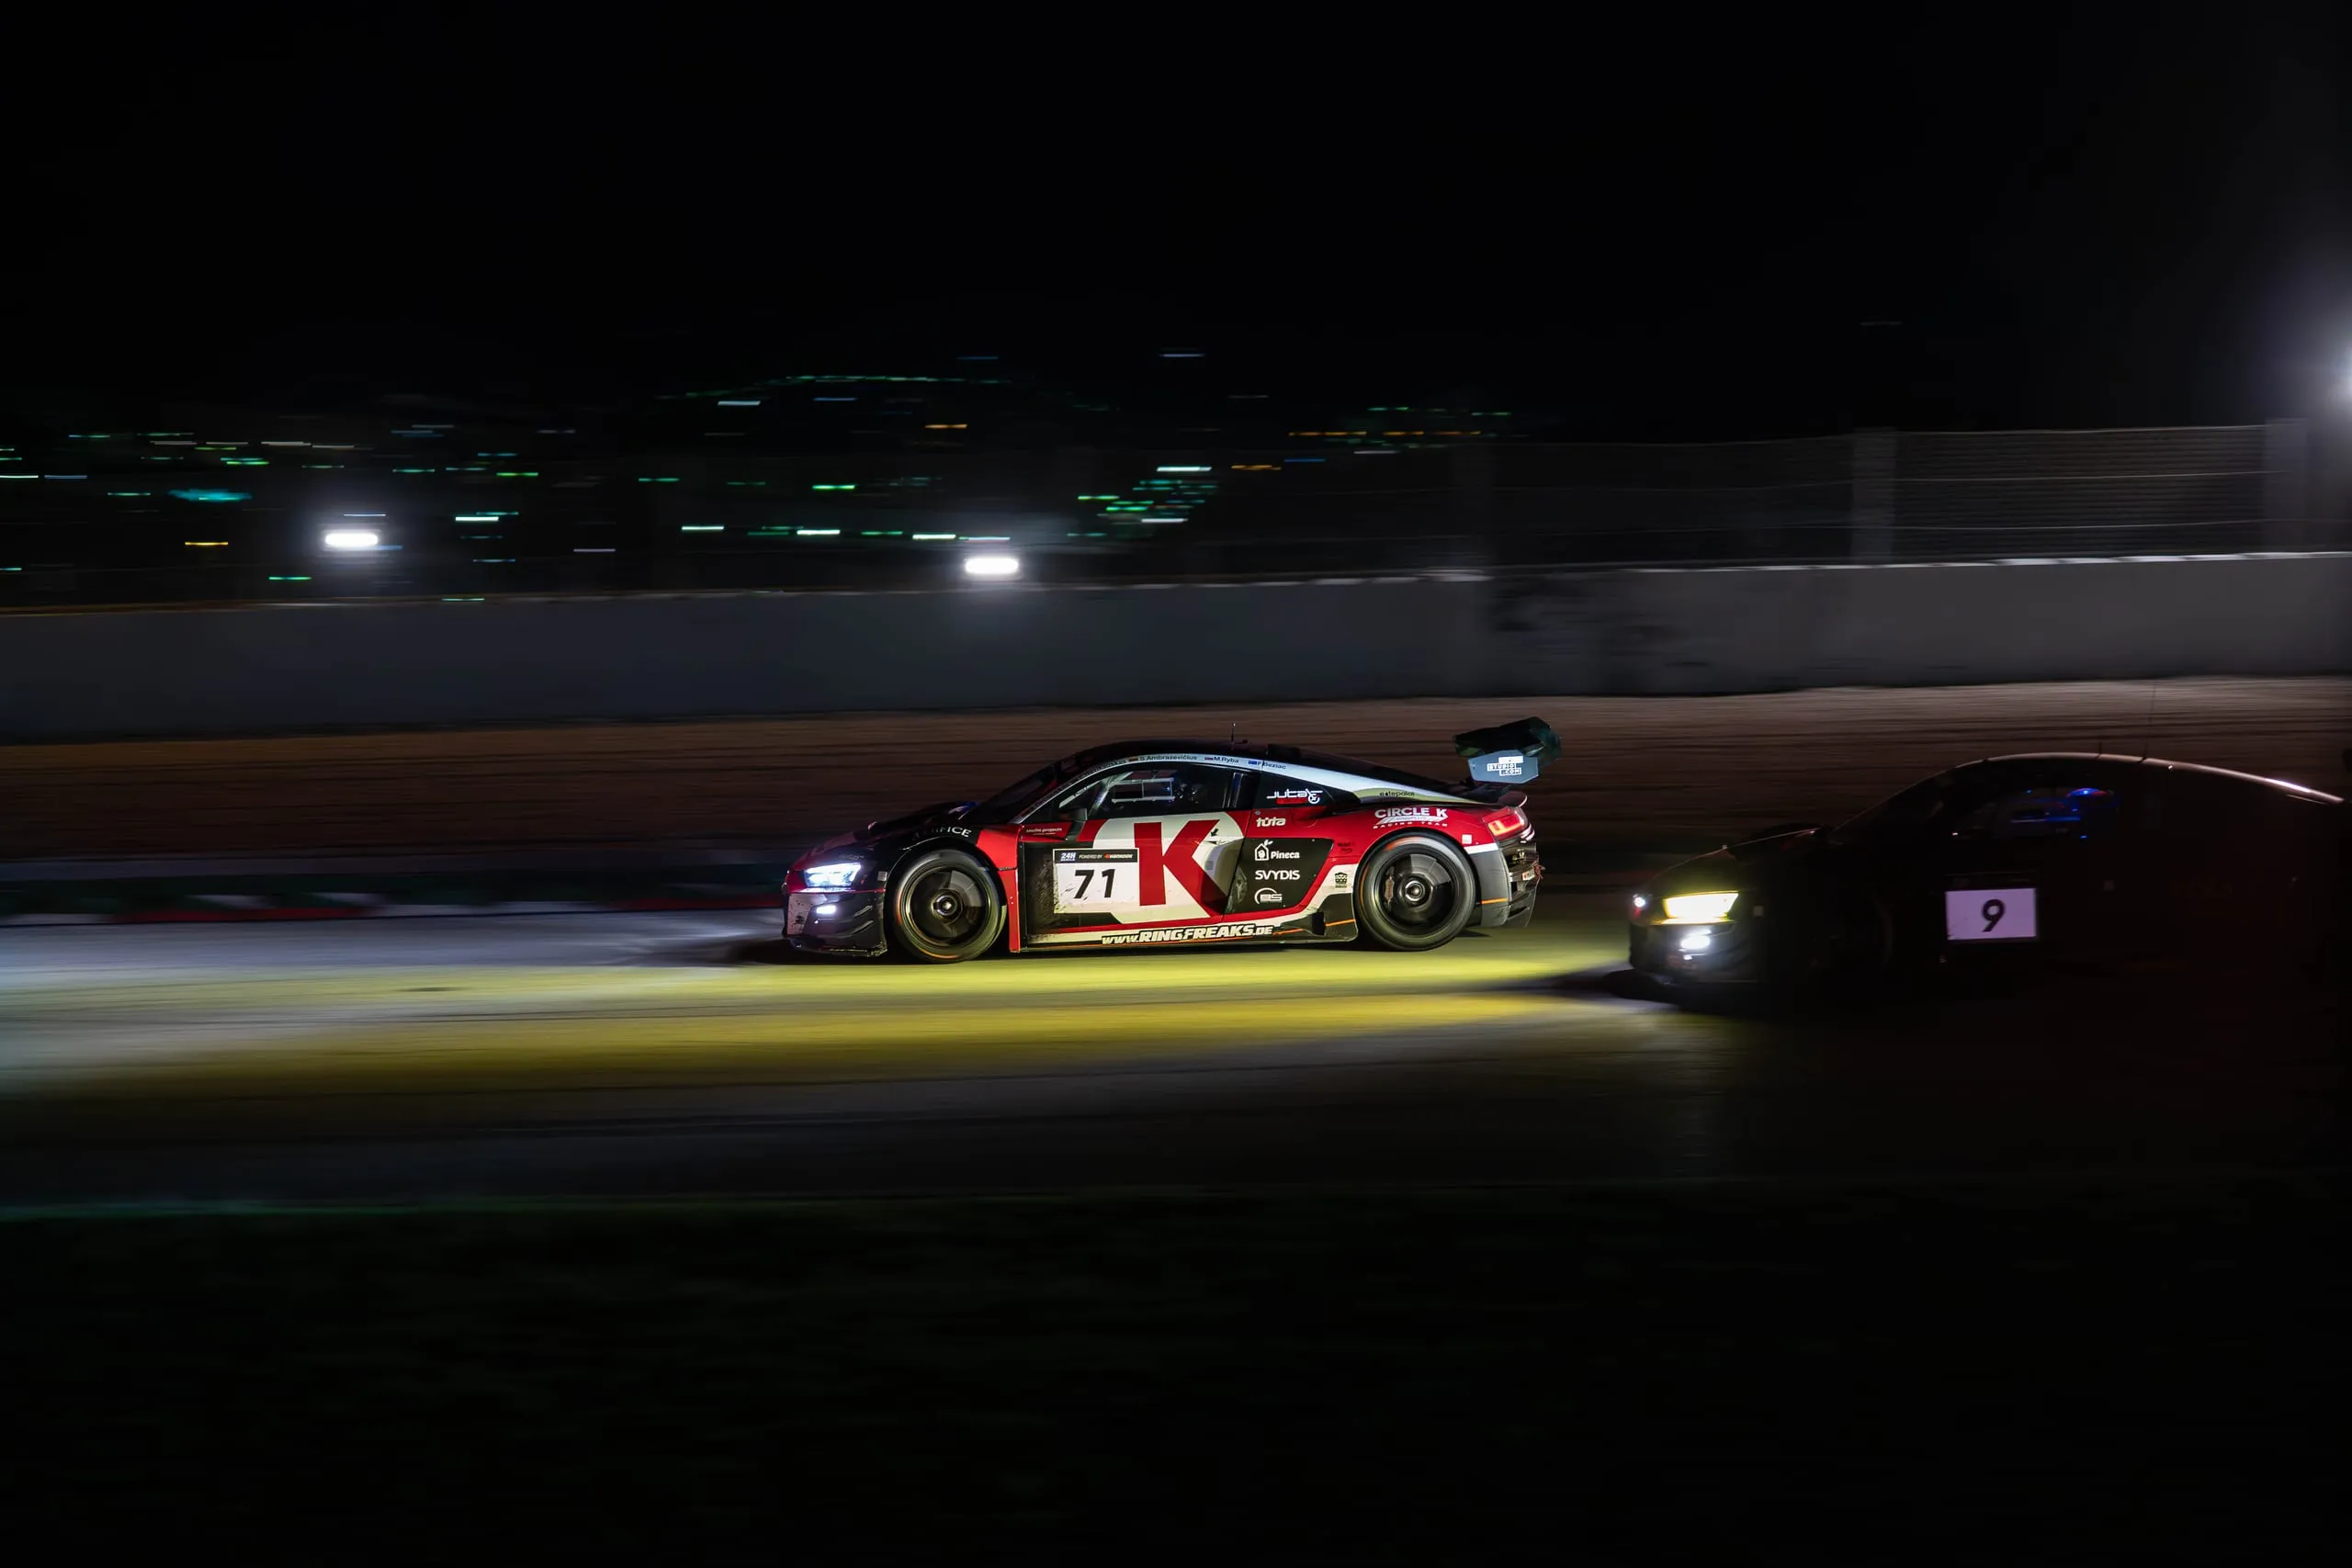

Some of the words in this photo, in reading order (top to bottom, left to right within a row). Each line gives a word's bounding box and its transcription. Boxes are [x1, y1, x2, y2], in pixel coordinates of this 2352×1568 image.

[1374, 807, 1430, 818] CIRCLE
[1436, 808, 1448, 818] K
[1271, 851, 1300, 860] Pineca
[1134, 819, 1229, 919] K
[1255, 870, 1301, 880] SVYDIS
[1073, 868, 1115, 899] 71
[1982, 898, 2006, 932] 9
